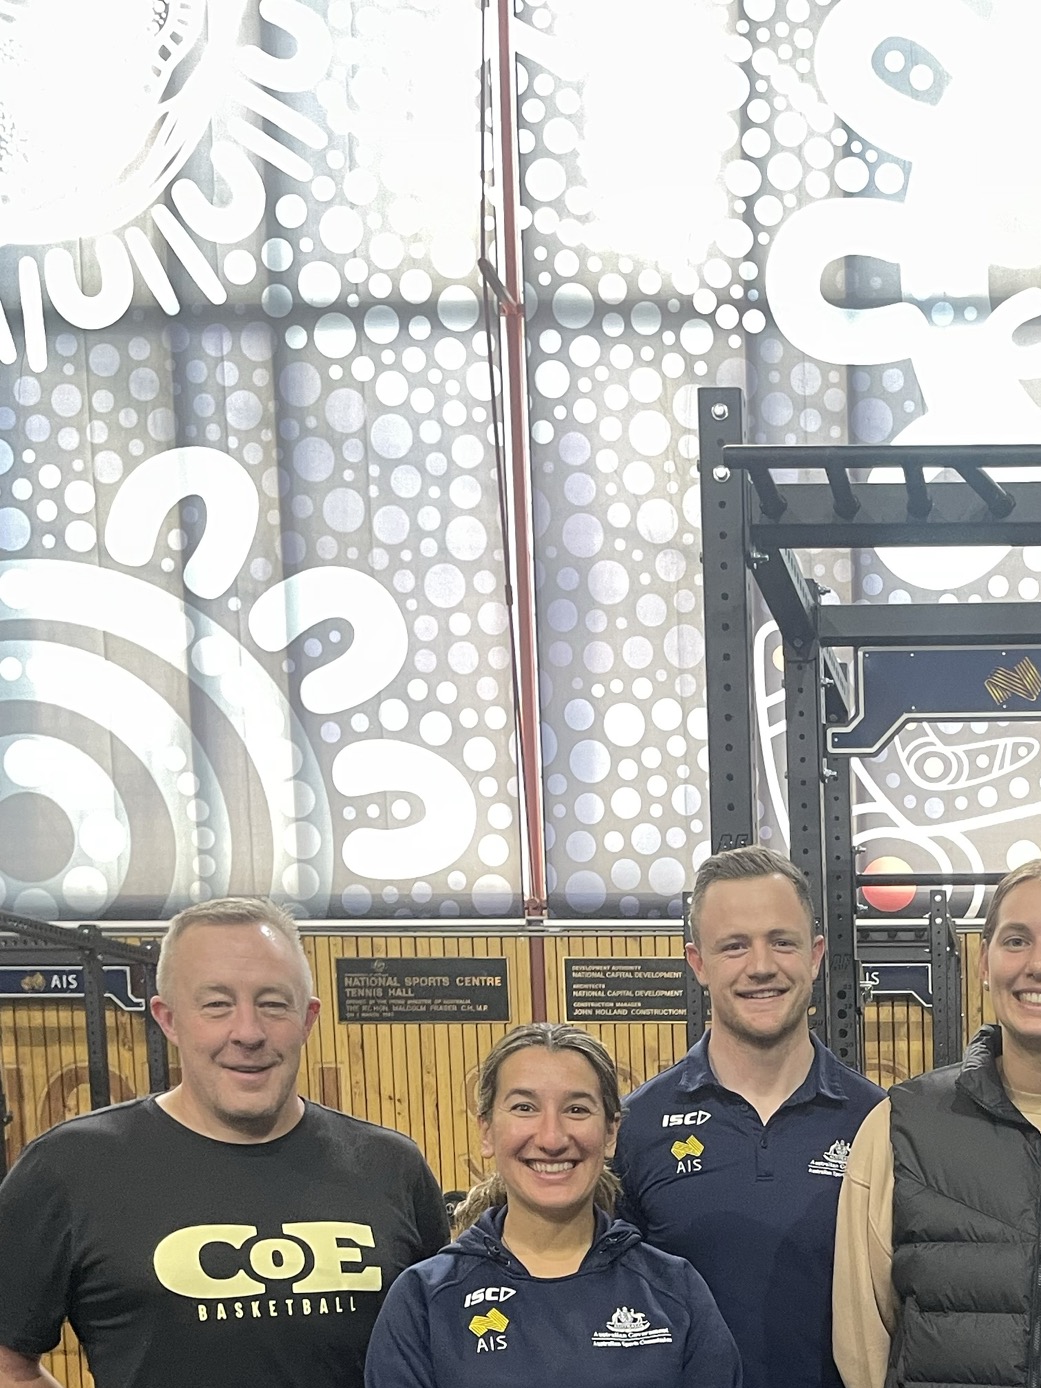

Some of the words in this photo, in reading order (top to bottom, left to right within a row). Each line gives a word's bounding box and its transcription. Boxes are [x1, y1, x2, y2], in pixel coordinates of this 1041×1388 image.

[50, 974, 79, 989] AIS
[345, 976, 400, 987] NATIONAL
[404, 976, 450, 987] SPORTS
[456, 976, 502, 987] CENTRE
[865, 971, 881, 985] IS
[345, 988, 383, 997] TENNIS
[388, 988, 415, 997] HALL
[676, 1158, 703, 1174] AIS
[197, 1296, 357, 1322] BASKETBALL
[476, 1335, 508, 1353] AIS
